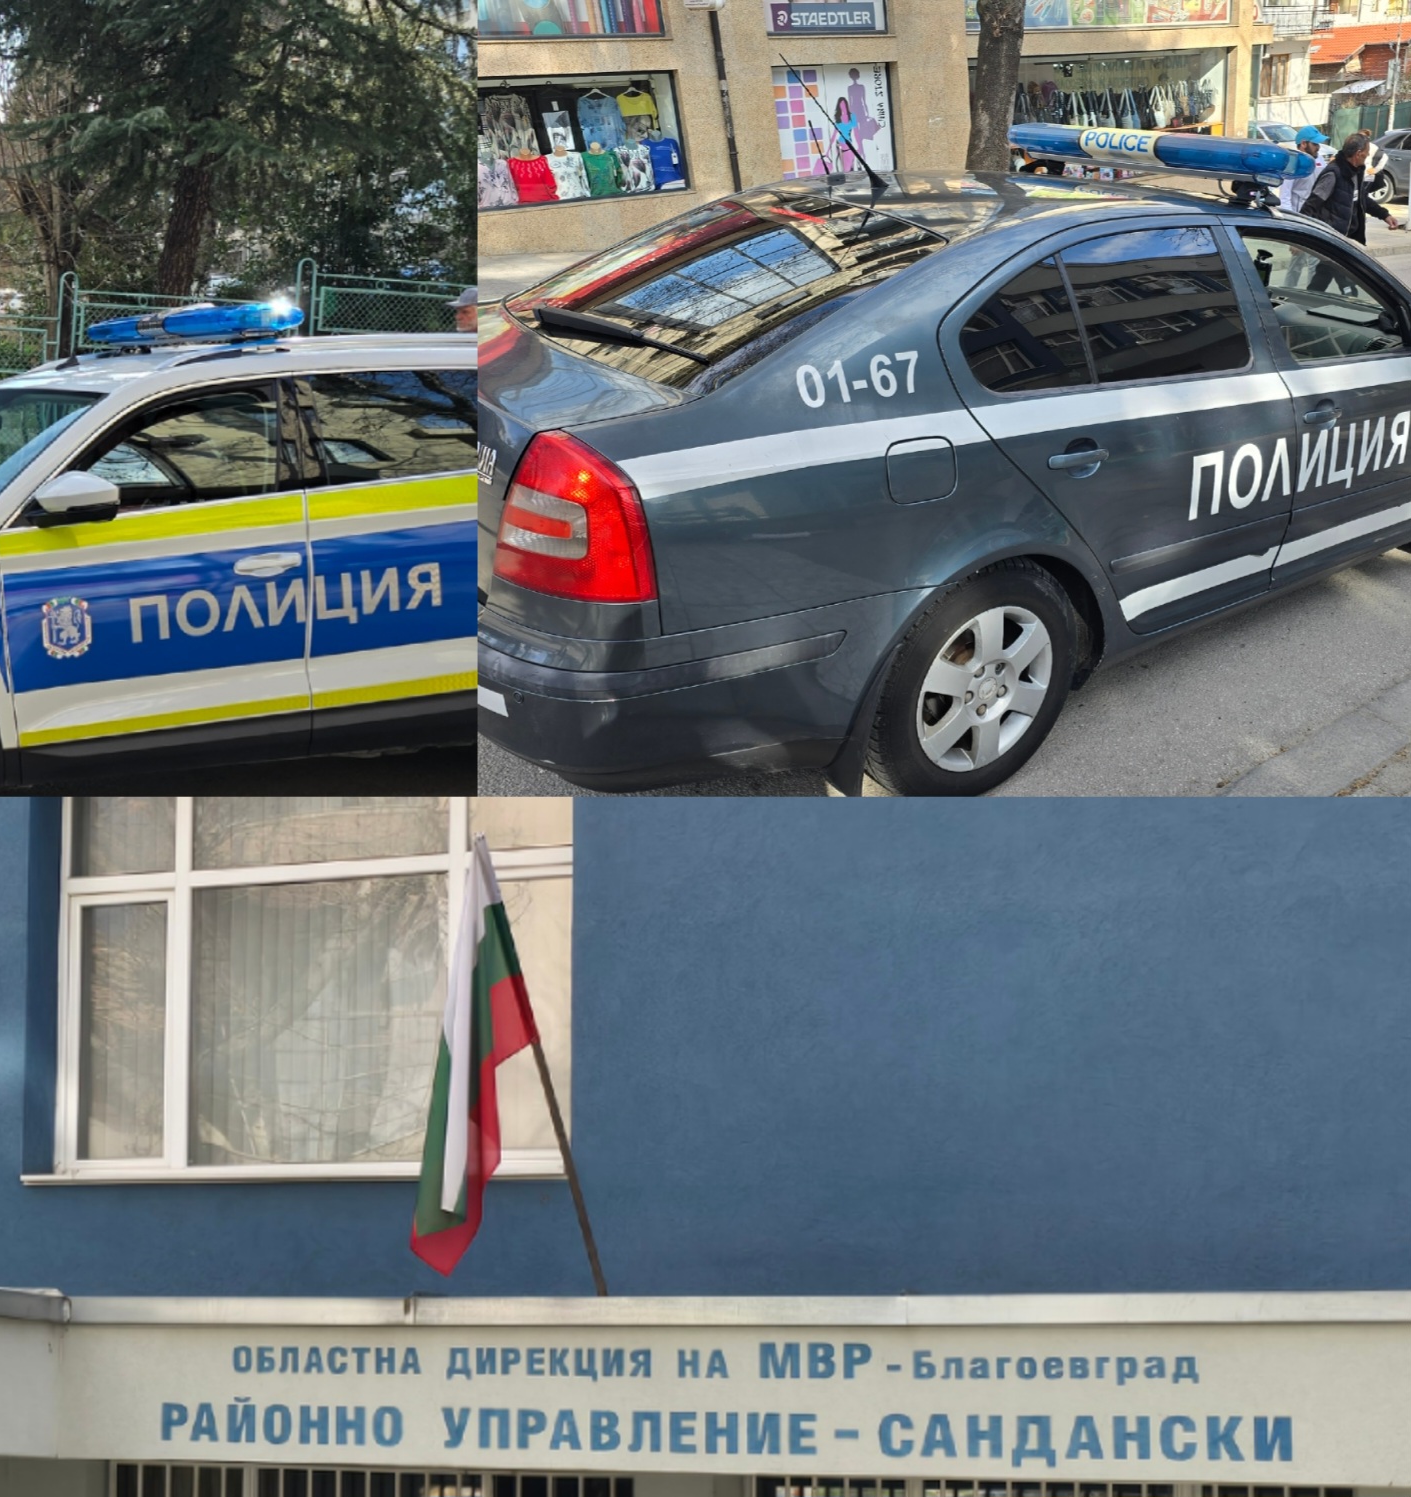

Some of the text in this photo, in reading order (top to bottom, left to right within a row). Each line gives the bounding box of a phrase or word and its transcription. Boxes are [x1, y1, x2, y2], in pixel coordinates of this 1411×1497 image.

[790, 11, 872, 26] STAEDTLER
[872, 63, 884, 98] STORE
[1084, 131, 1152, 153] POLICE
[796, 350, 918, 409] 01-67
[1188, 410, 1411, 521] ПОЛИЦИЯ
[128, 562, 442, 644] ПОЛИЦИЯ
[232, 1345, 422, 1375] ОБЛАСТНА
[446, 1346, 653, 1382] ДИРЕКЦИЯ
[677, 1348, 730, 1379] НА
[758, 1342, 873, 1380] МВР
[912, 1349, 1200, 1386] Благоевград
[160, 1396, 405, 1447] РАЙОННО
[441, 1406, 819, 1455] УПРАВЛЕНИЕ
[877, 1412, 1295, 1468] САНДАНСКИ
